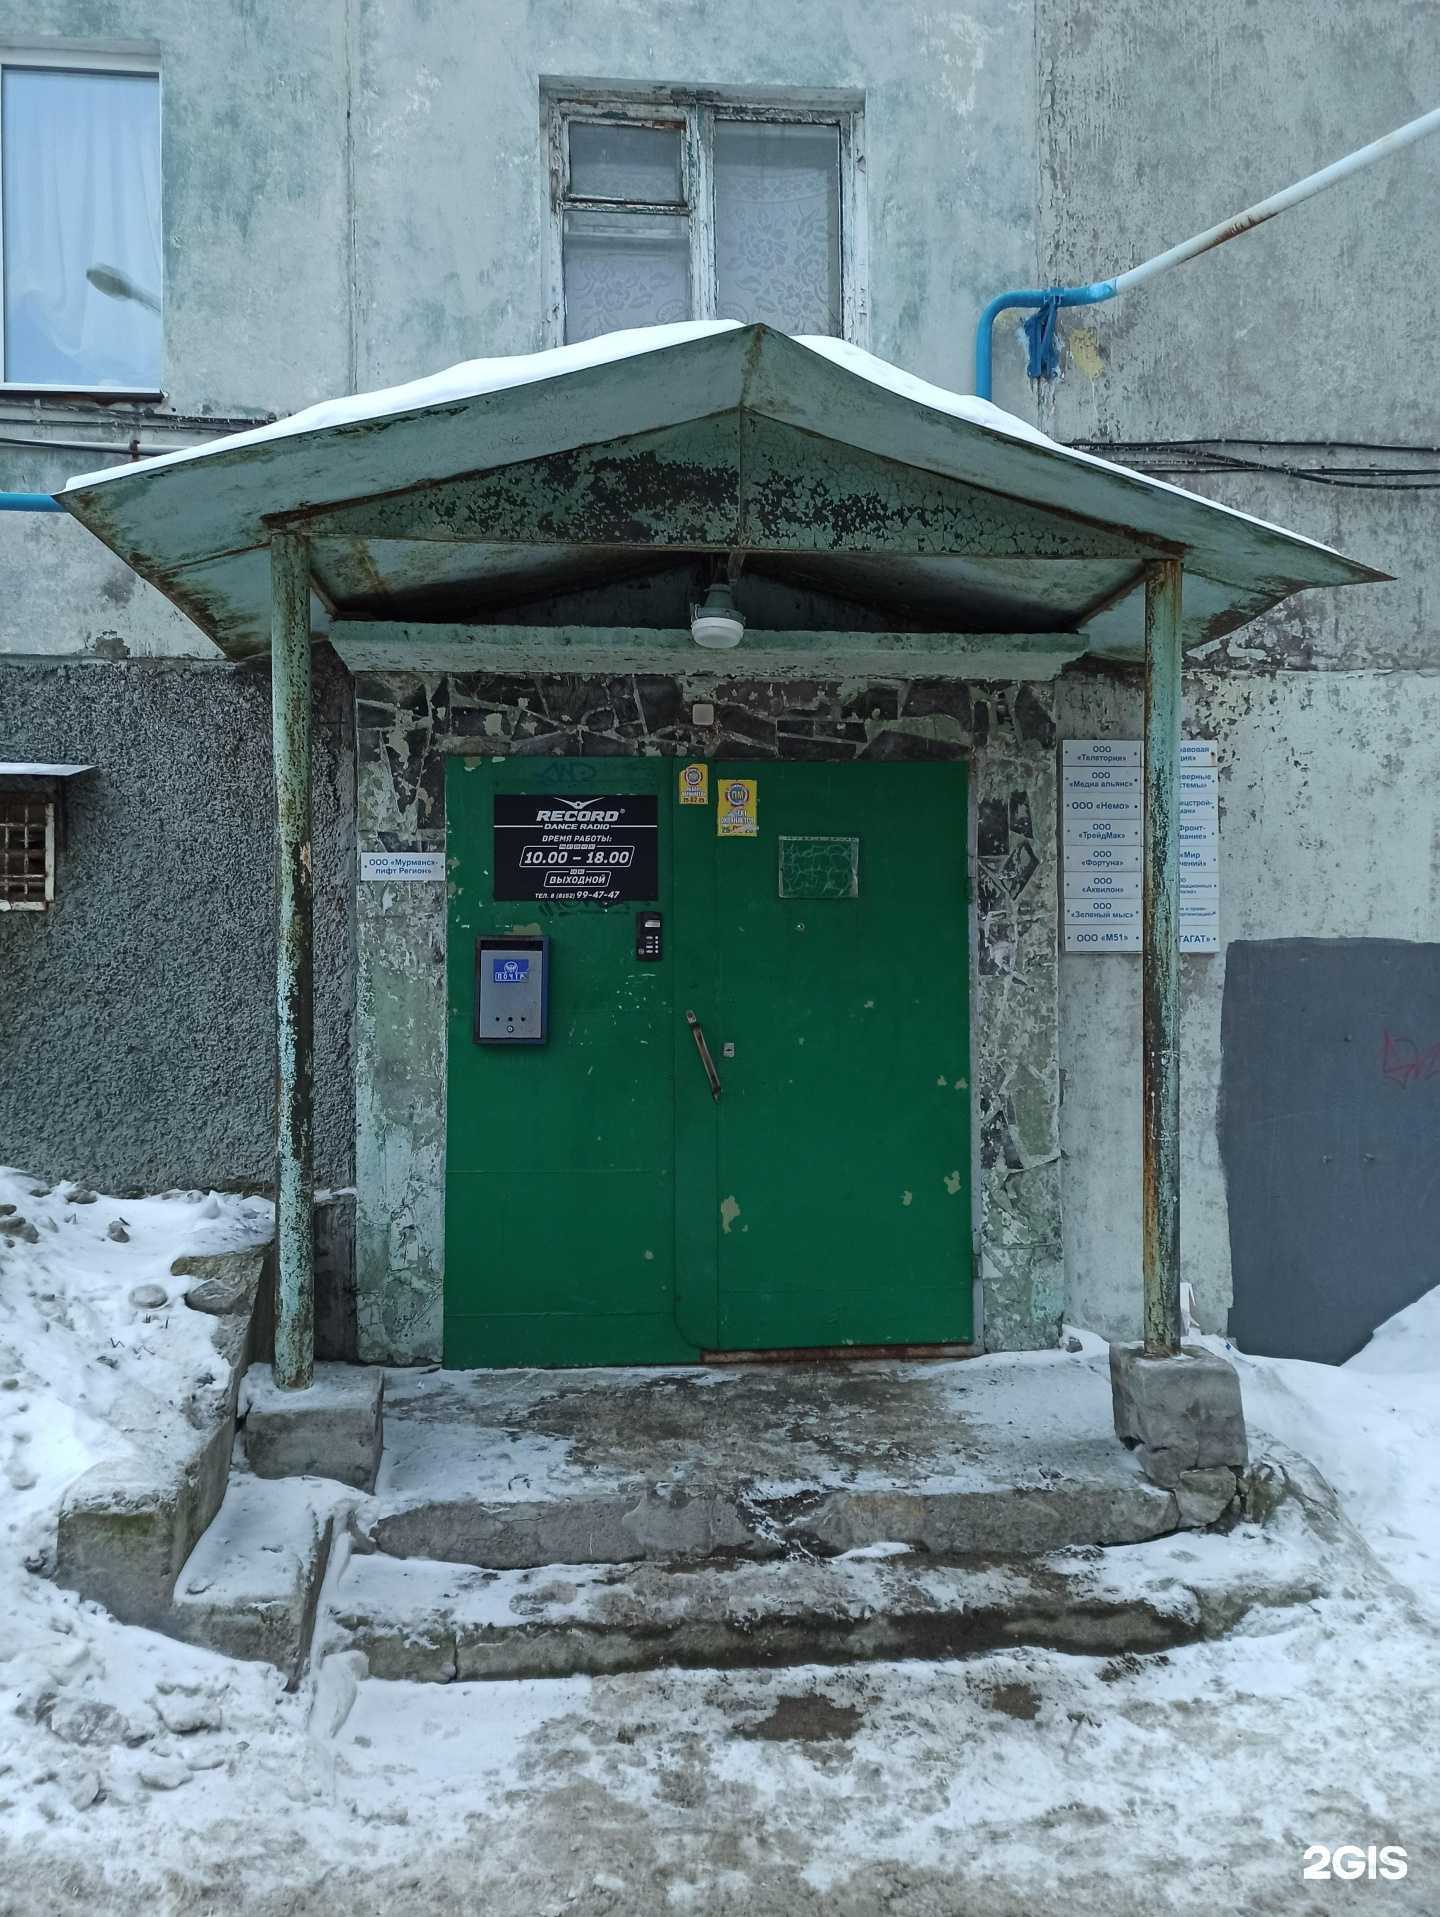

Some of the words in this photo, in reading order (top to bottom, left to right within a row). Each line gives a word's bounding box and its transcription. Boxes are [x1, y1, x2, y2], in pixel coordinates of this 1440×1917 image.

[536, 810, 620, 822] RECORD
[524, 851, 568, 864] 10.00
[586, 851, 630, 864] 18.00
[1082, 860, 1124, 868] «Фортуна»
[550, 874, 606, 884] ВЫХОДНОЙ
[576, 891, 620, 899] 99-47-47
